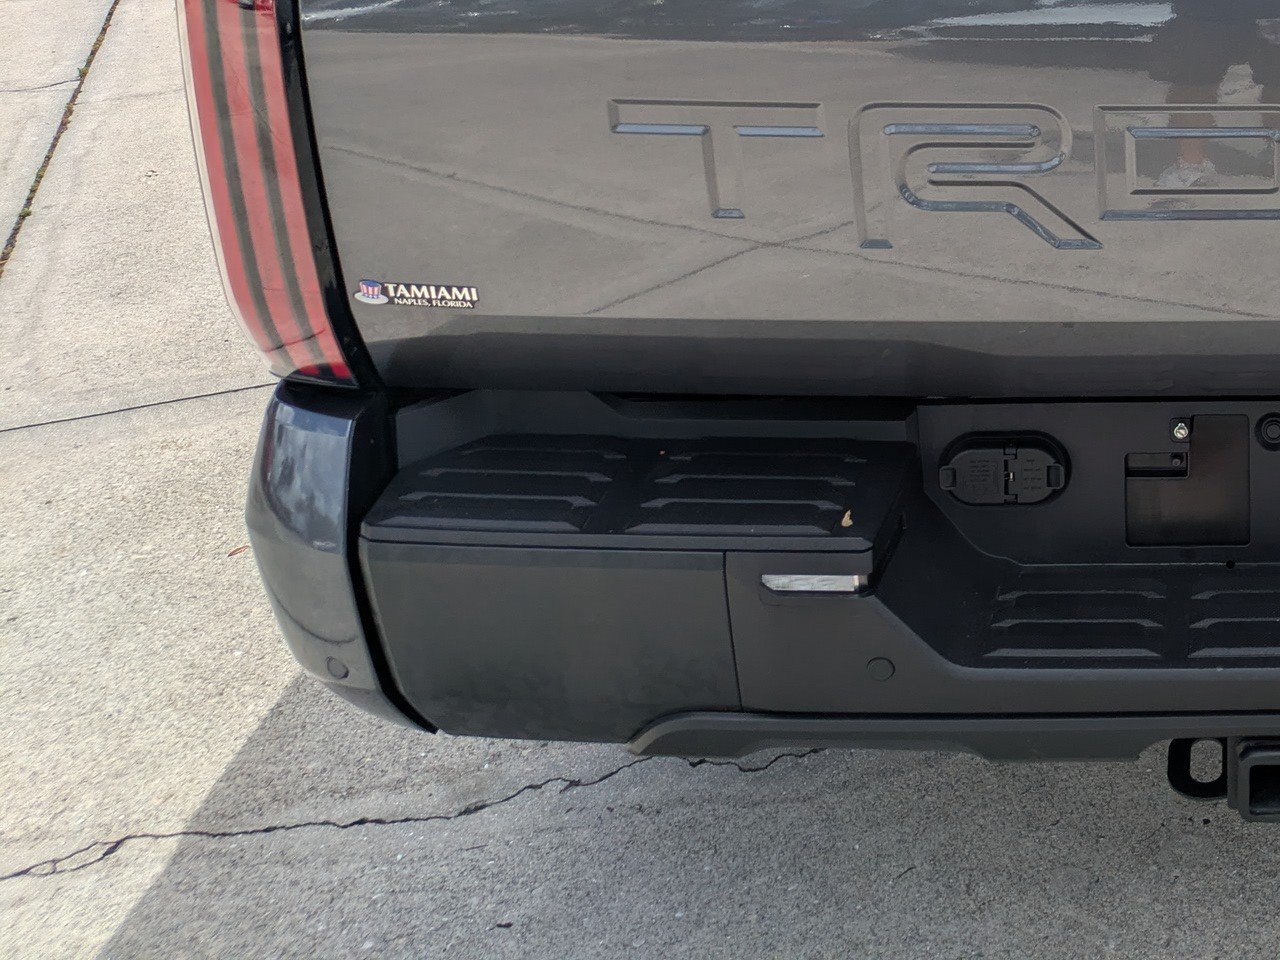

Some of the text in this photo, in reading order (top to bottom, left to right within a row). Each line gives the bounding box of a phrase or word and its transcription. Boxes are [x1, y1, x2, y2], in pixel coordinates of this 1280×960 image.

[384, 283, 479, 301] TAMIAMI
[394, 298, 473, 309] NAPLES, FLORIDA
